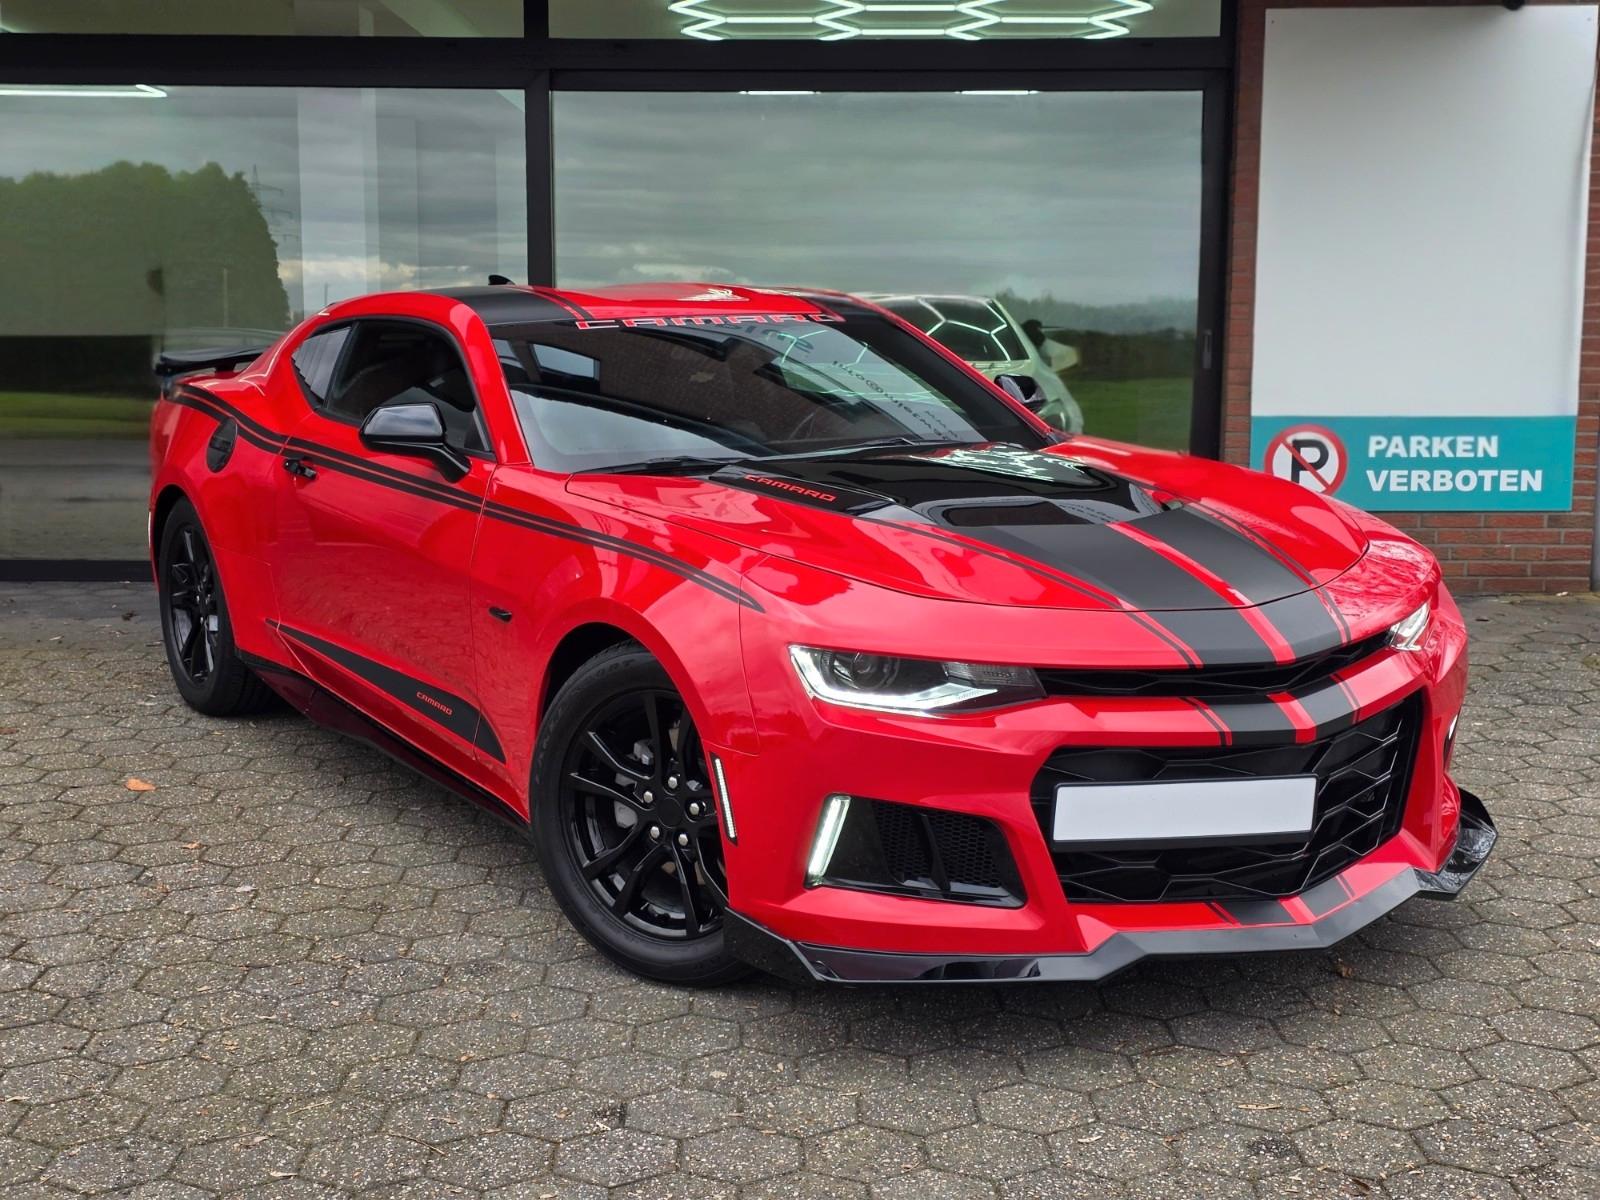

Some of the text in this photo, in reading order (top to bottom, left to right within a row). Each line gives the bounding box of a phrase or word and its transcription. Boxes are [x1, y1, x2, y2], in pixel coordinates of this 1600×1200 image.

[1368, 435, 1498, 458] PARKEN
[743, 473, 838, 503] CAMARO
[1366, 469, 1544, 492] VERBOTEN
[416, 691, 453, 716] CAMARO
